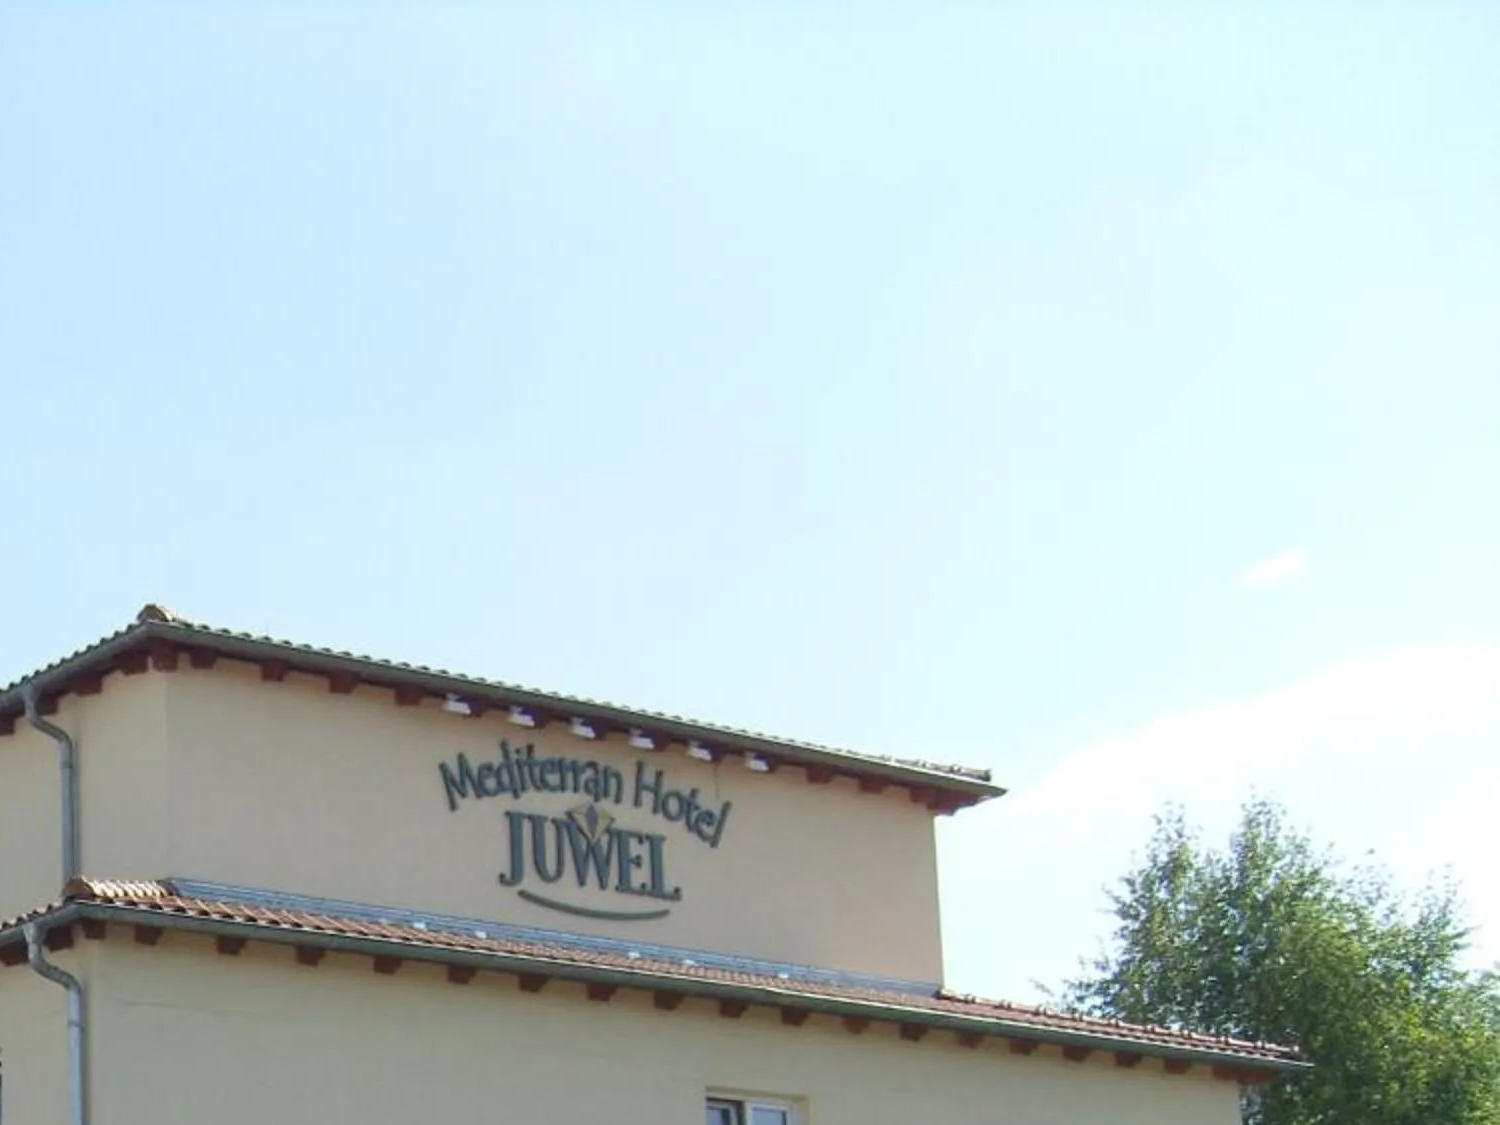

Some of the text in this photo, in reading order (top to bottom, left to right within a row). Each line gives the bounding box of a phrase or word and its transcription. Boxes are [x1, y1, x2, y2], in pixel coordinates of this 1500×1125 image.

[438, 738, 732, 849] Mediterran Hotel
[497, 810, 683, 901] JUWEL
